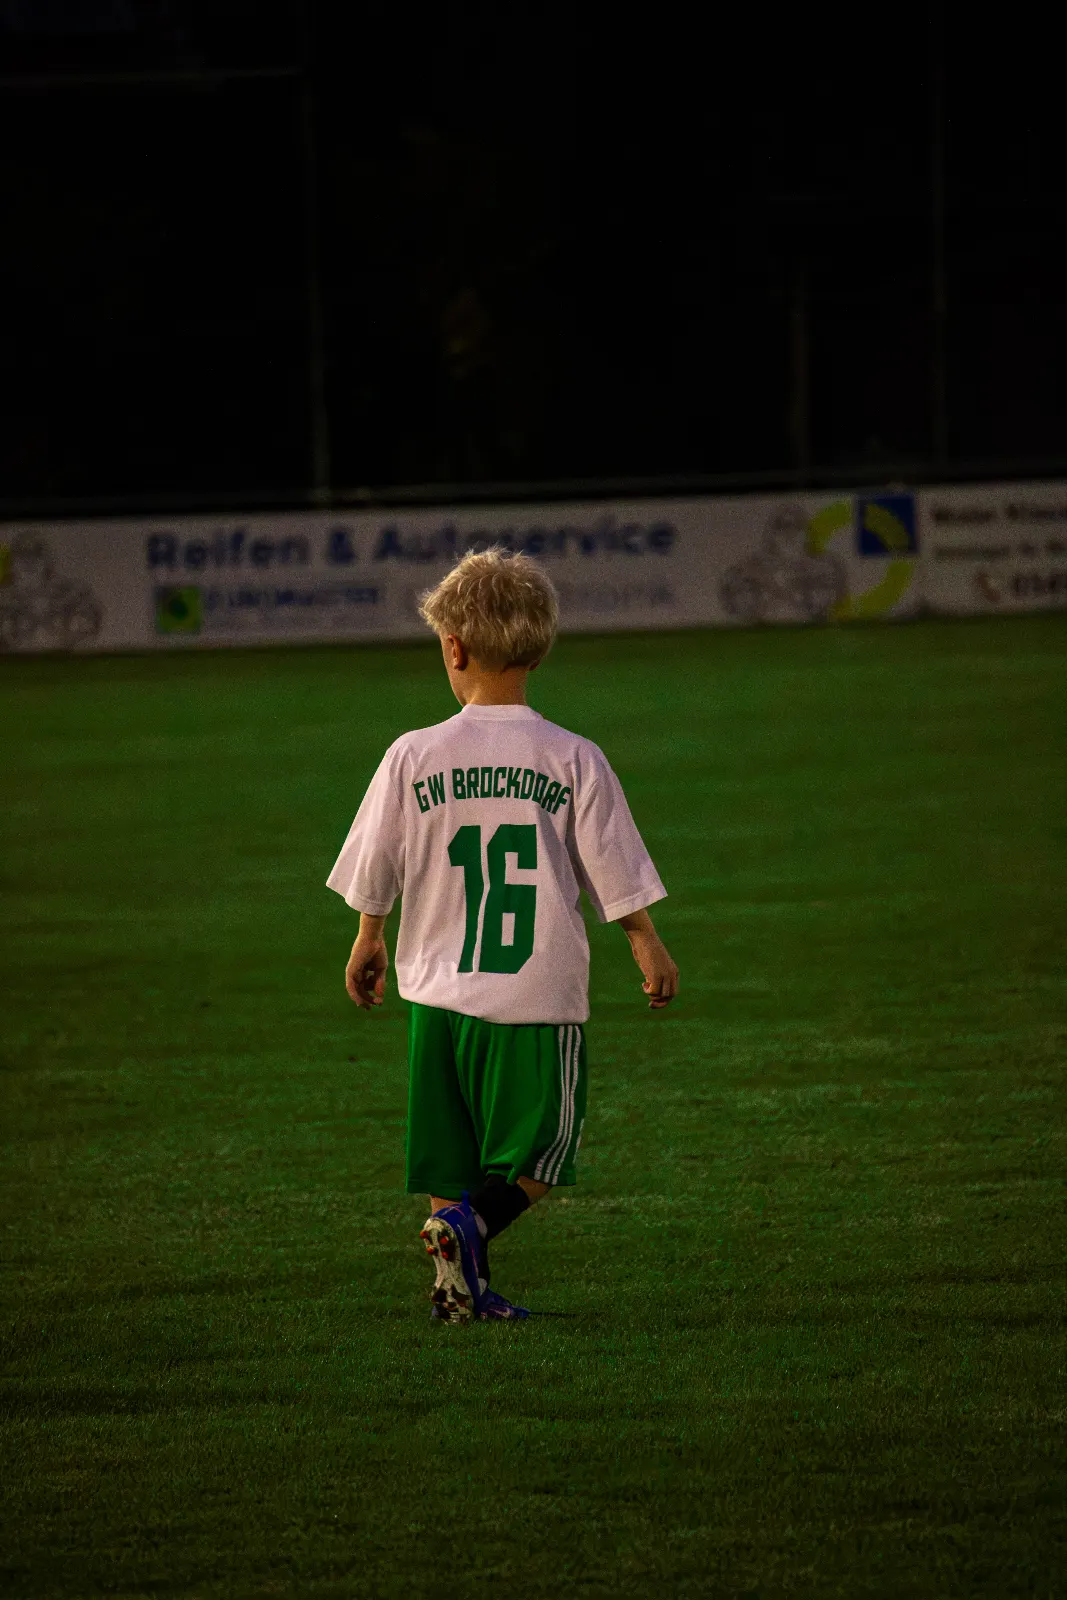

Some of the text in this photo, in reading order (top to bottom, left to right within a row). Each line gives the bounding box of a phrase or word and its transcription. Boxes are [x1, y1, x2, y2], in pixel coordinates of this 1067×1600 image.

[147, 528, 309, 569] Reifen
[327, 525, 355, 563] &
[413, 766, 571, 815] GW BROCKDORF
[448, 824, 537, 974] 16
